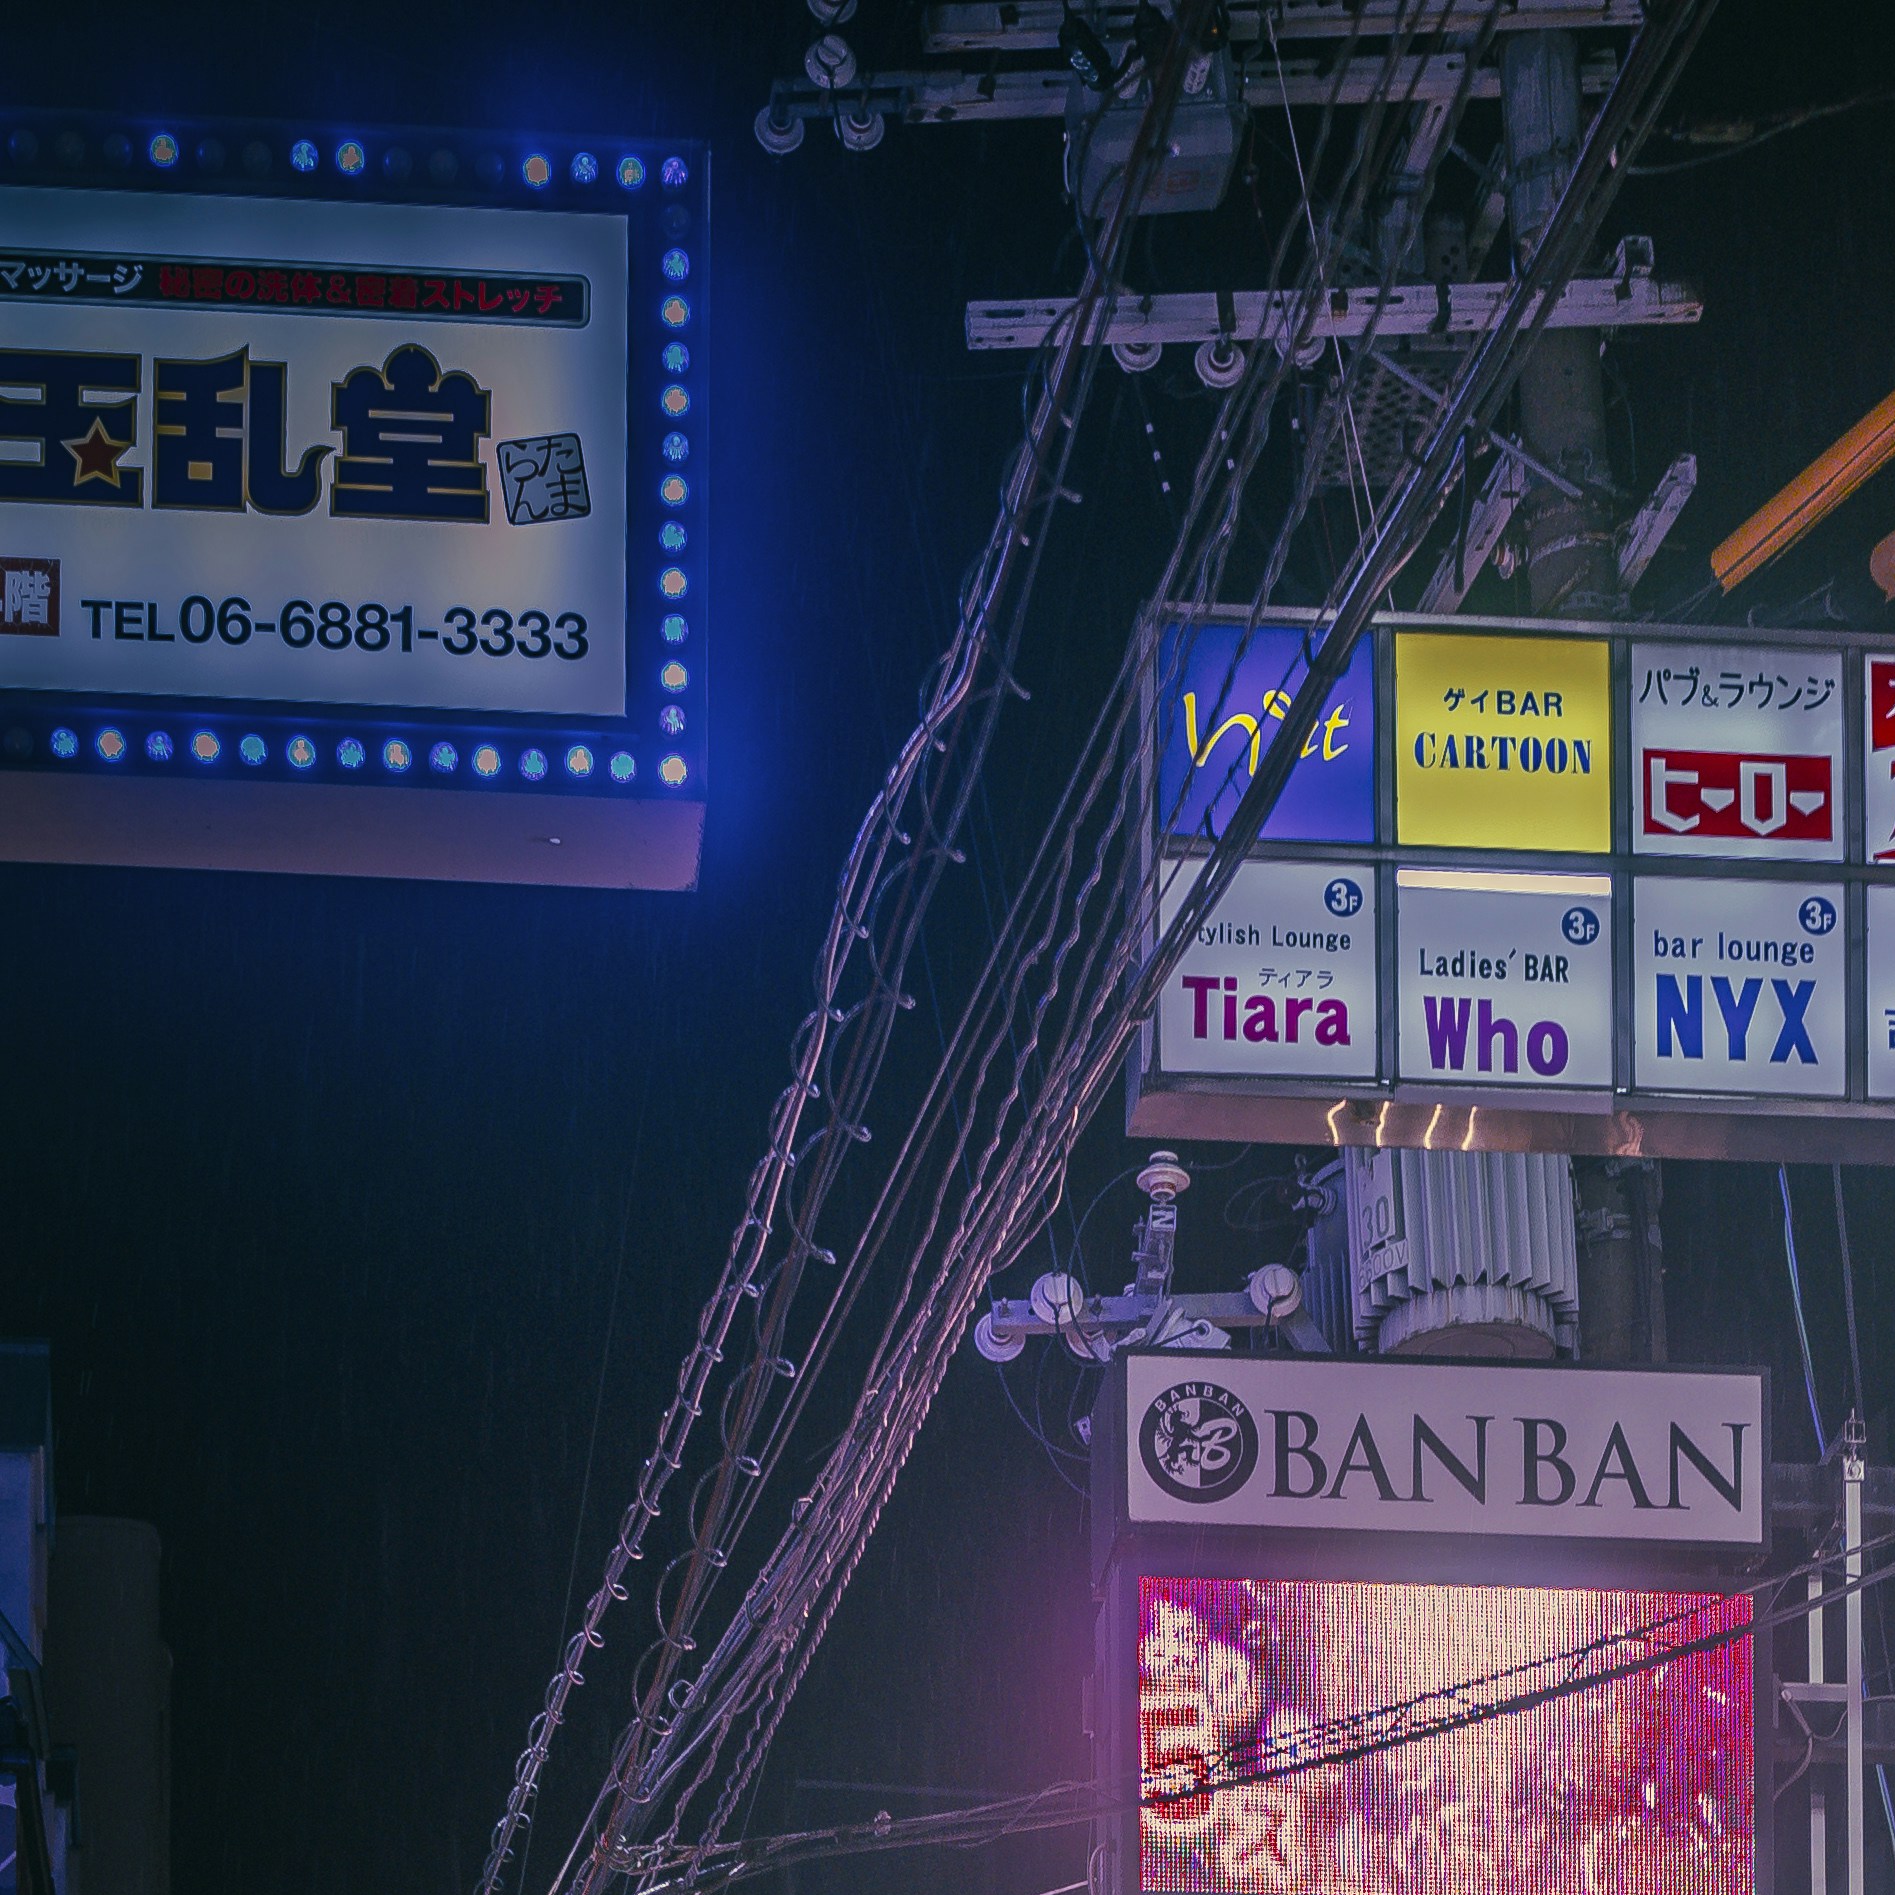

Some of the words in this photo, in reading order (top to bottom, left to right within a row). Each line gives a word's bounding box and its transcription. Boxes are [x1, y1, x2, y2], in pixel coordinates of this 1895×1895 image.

[3, 568, 52, 625] 階
[1442, 686, 1564, 718] ゲイBAR
[1638, 668, 1836, 712] パブ&ラウンジ
[1412, 731, 1593, 776] CARTOON
[1650, 756, 1826, 837] ヒーロー
[1330, 882, 1359, 914] 3F
[1804, 898, 1833, 933] 3F
[1272, 926, 1351, 952] Lounge
[1567, 909, 1597, 944] 3F
[1652, 927, 1706, 960] bar
[1716, 929, 1815, 967] lounge
[1258, 967, 1335, 990] ティアラ
[1523, 952, 1570, 984] BAR
[1182, 975, 1351, 1047] Tiara
[1656, 975, 1818, 1065] NYX
[1425, 995, 1569, 1077] Who
[1153, 1382, 1247, 1419] BANBAN
